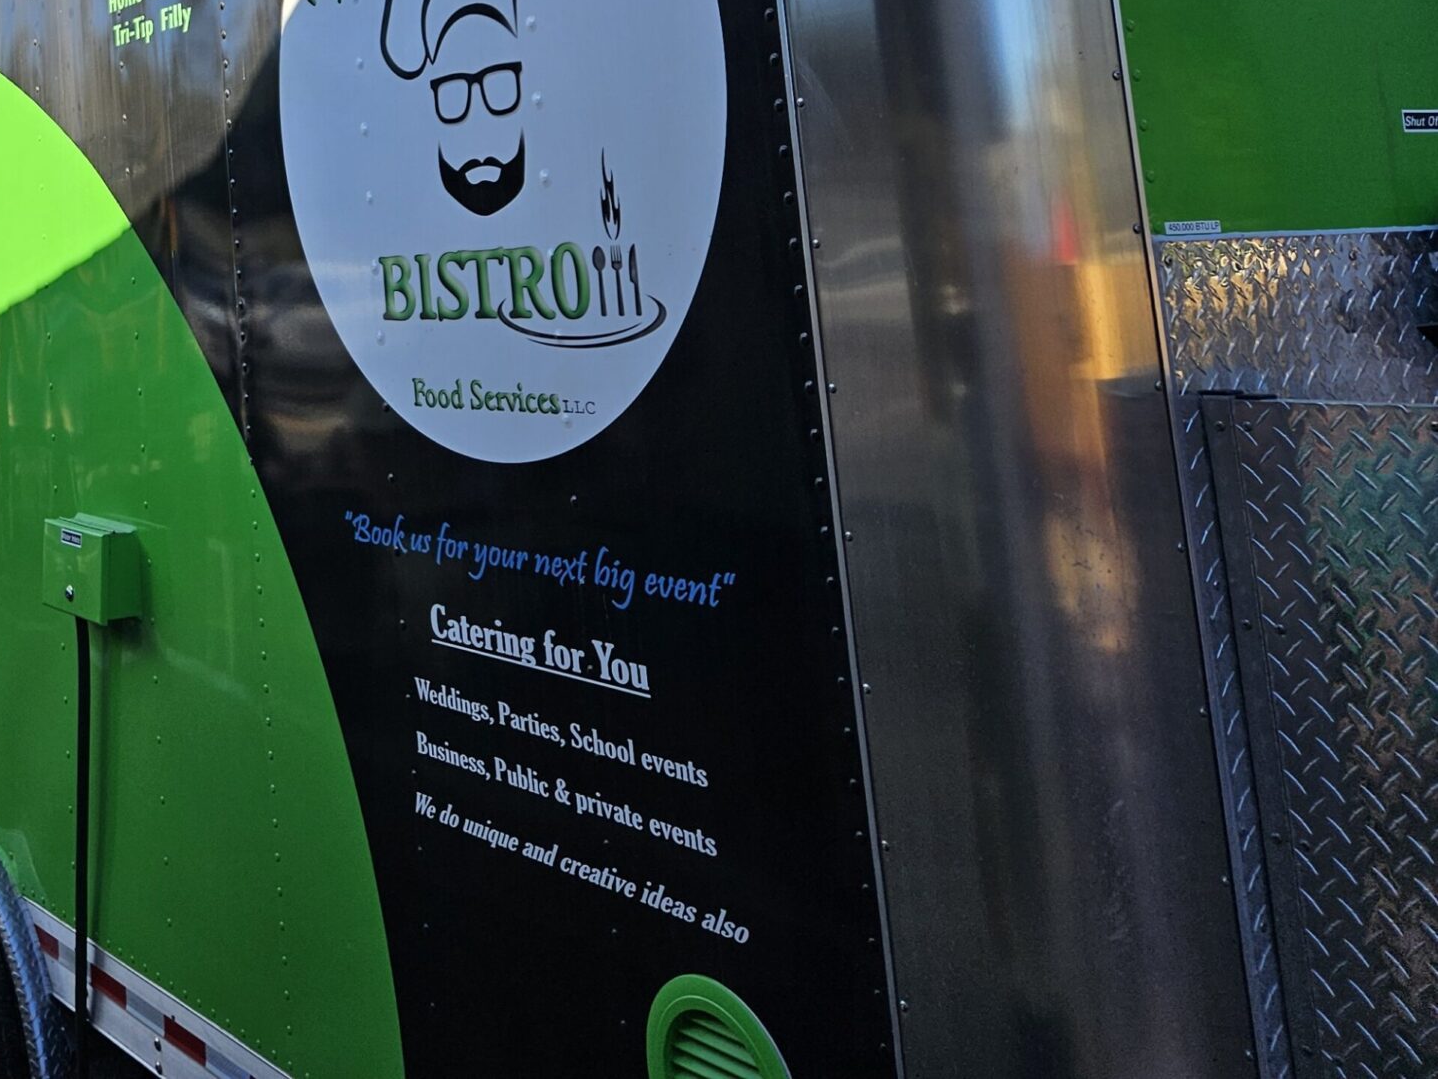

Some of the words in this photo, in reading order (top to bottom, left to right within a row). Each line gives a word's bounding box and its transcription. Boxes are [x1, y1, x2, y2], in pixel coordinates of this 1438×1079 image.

[113, 15, 154, 47] Tri-Tip
[160, 3, 192, 33] Filly
[1405, 115, 1425, 127] Shut
[1195, 222, 1209, 231] BTU
[378, 241, 590, 321] BISTRO
[412, 377, 465, 410] Food
[470, 379, 560, 414] Services
[562, 399, 596, 415] LLC
[344, 510, 407, 554] "Book
[410, 535, 431, 555] us
[436, 522, 468, 565] for
[468, 544, 528, 581] your
[534, 550, 588, 586] next
[594, 546, 635, 610] big
[644, 571, 735, 608] event"
[430, 603, 536, 666] Catering
[543, 629, 585, 674] for
[591, 639, 650, 691] You
[414, 676, 494, 725] Weddings,
[497, 701, 566, 747] Parties,
[569, 723, 636, 766] School
[641, 751, 709, 788] events
[415, 730, 491, 781] Business,
[494, 756, 550, 798] Public
[554, 778, 571, 806] &
[575, 791, 644, 831] private
[649, 816, 718, 857] events
[414, 791, 436, 819] We
[439, 804, 460, 828] do
[462, 817, 519, 852] unique
[521, 843, 558, 868] and
[560, 855, 637, 898] creative
[640, 880, 697, 923] ideas
[701, 908, 750, 944] also
